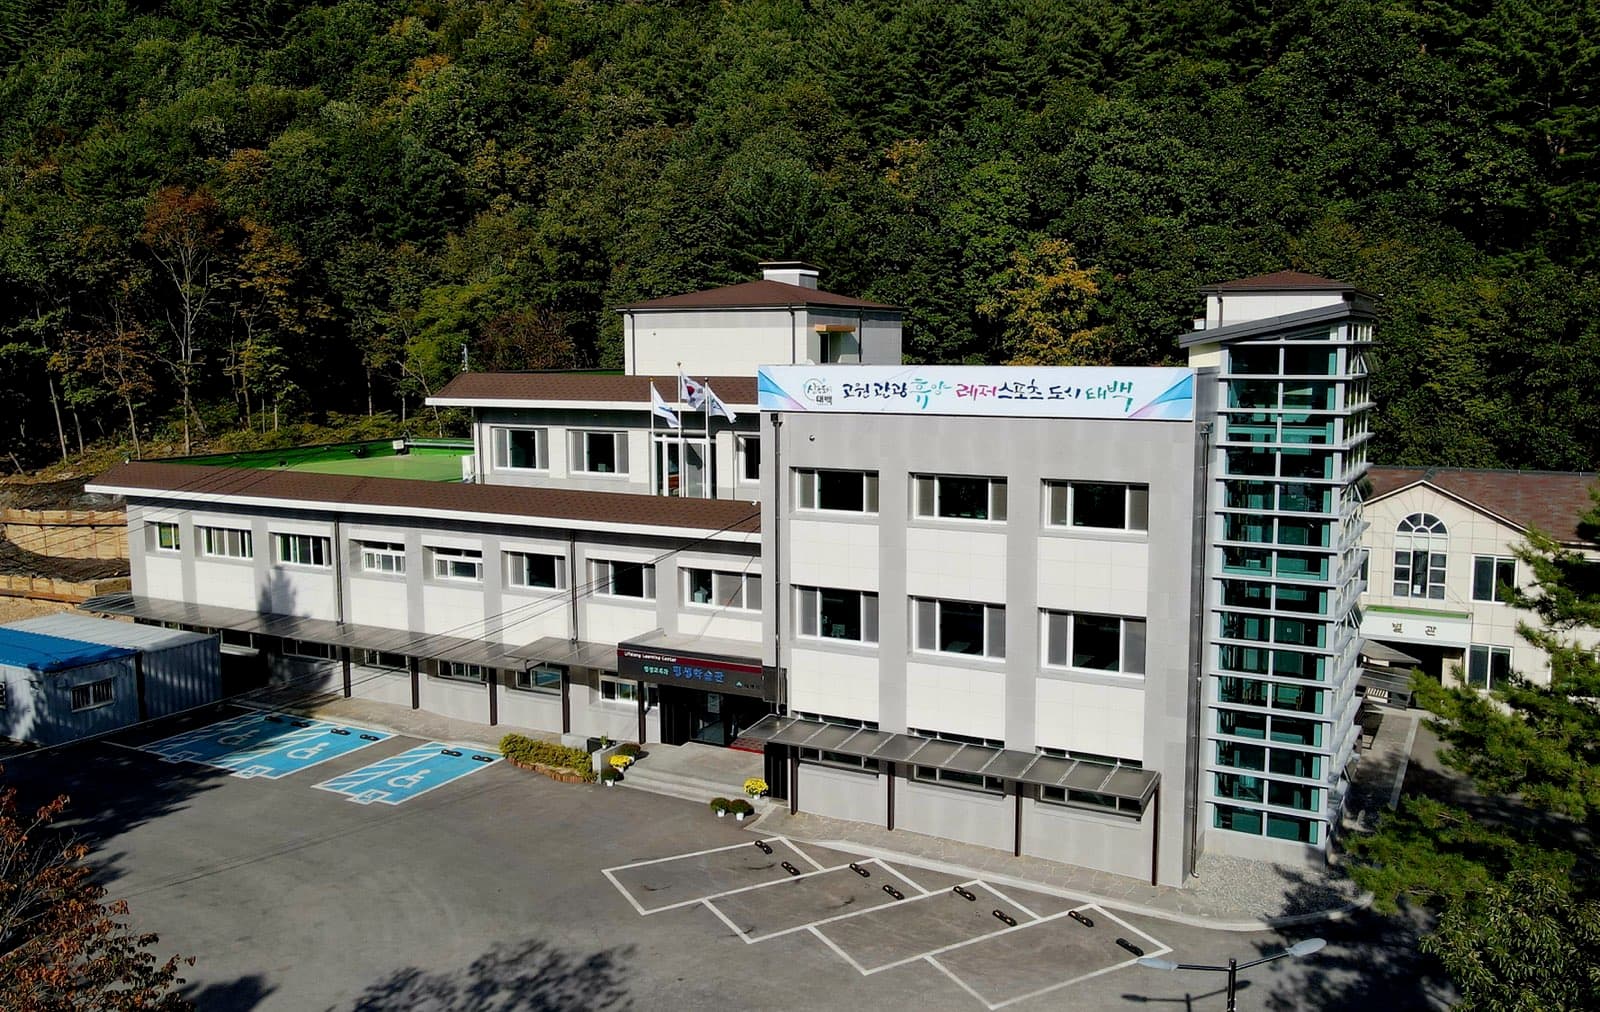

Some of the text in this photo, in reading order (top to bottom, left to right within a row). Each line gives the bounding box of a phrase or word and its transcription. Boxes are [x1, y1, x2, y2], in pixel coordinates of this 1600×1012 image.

[842, 378, 1134, 413] 고원 관광 휴양 레저 스포츠 도시 태백
[661, 655, 677, 663] Center
[672, 665, 725, 683] 평생학습관
